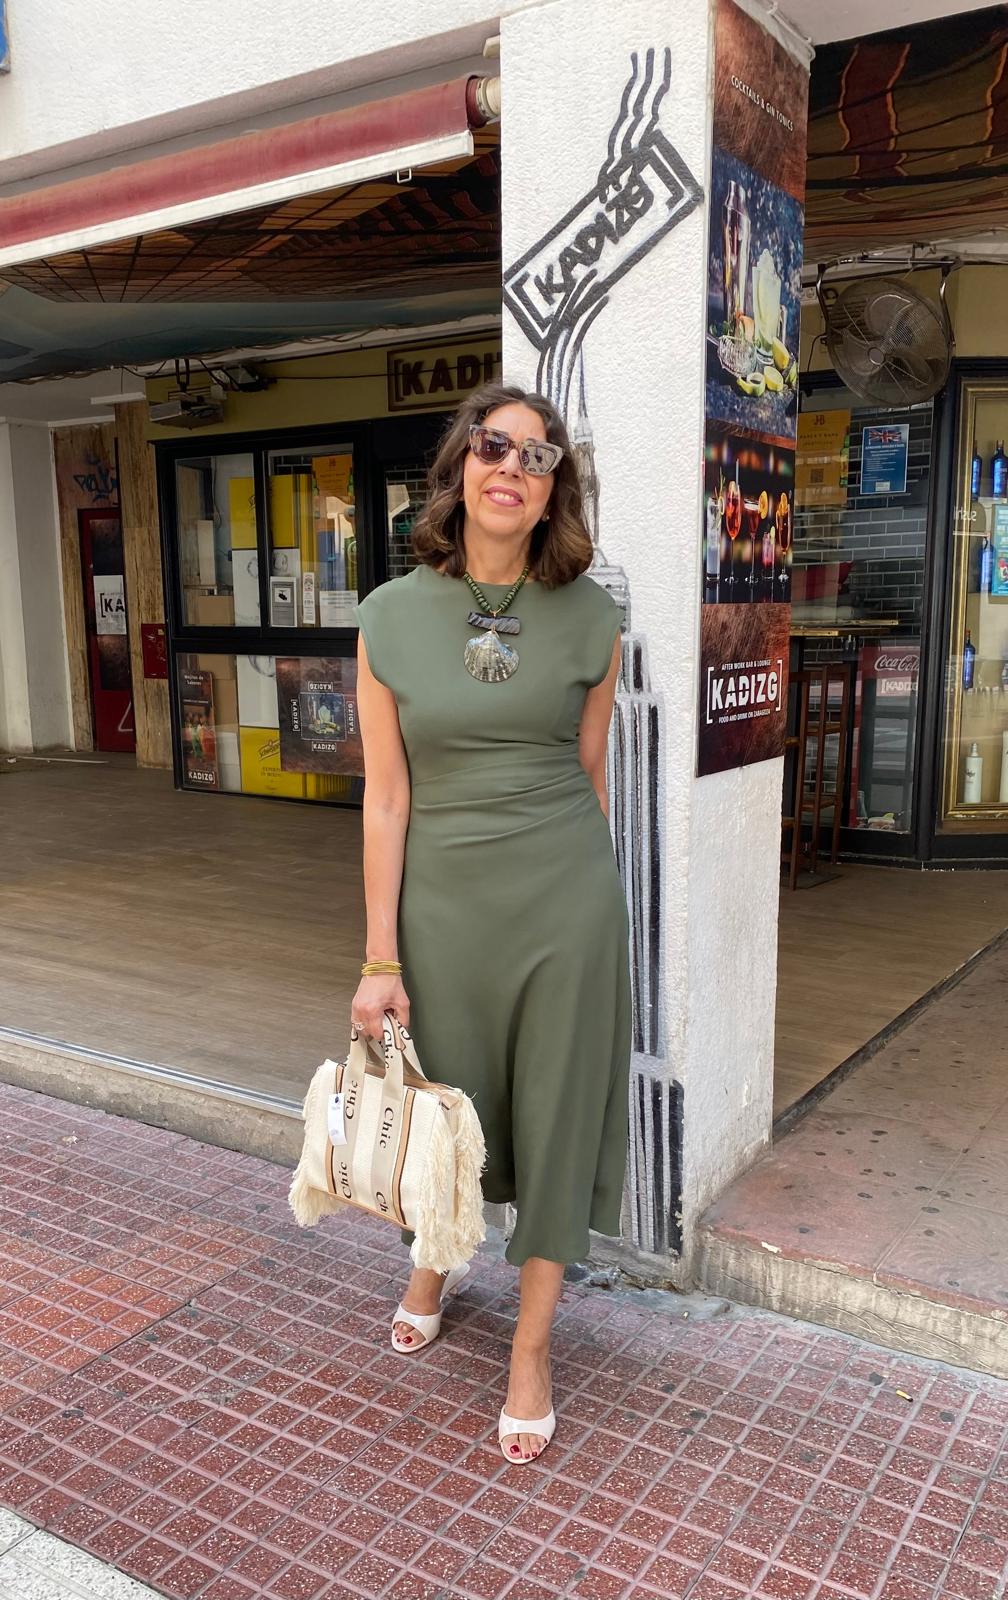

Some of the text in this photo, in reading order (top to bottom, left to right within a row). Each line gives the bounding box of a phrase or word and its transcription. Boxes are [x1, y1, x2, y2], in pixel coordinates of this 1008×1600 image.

[731, 74, 760, 104] COCKTAILS
[766, 102, 775, 116] GIN
[776, 110, 793, 132] TONICS
[402, 351, 502, 396] KADI
[104, 598, 124, 612] KA
[712, 670, 778, 711] KADIZG
[718, 716, 729, 724] FOOD
[188, 771, 214, 782] KADIZG
[346, 1080, 358, 1119] Chic
[380, 1107, 394, 1148] Chic
[339, 1162, 352, 1198] Chic
